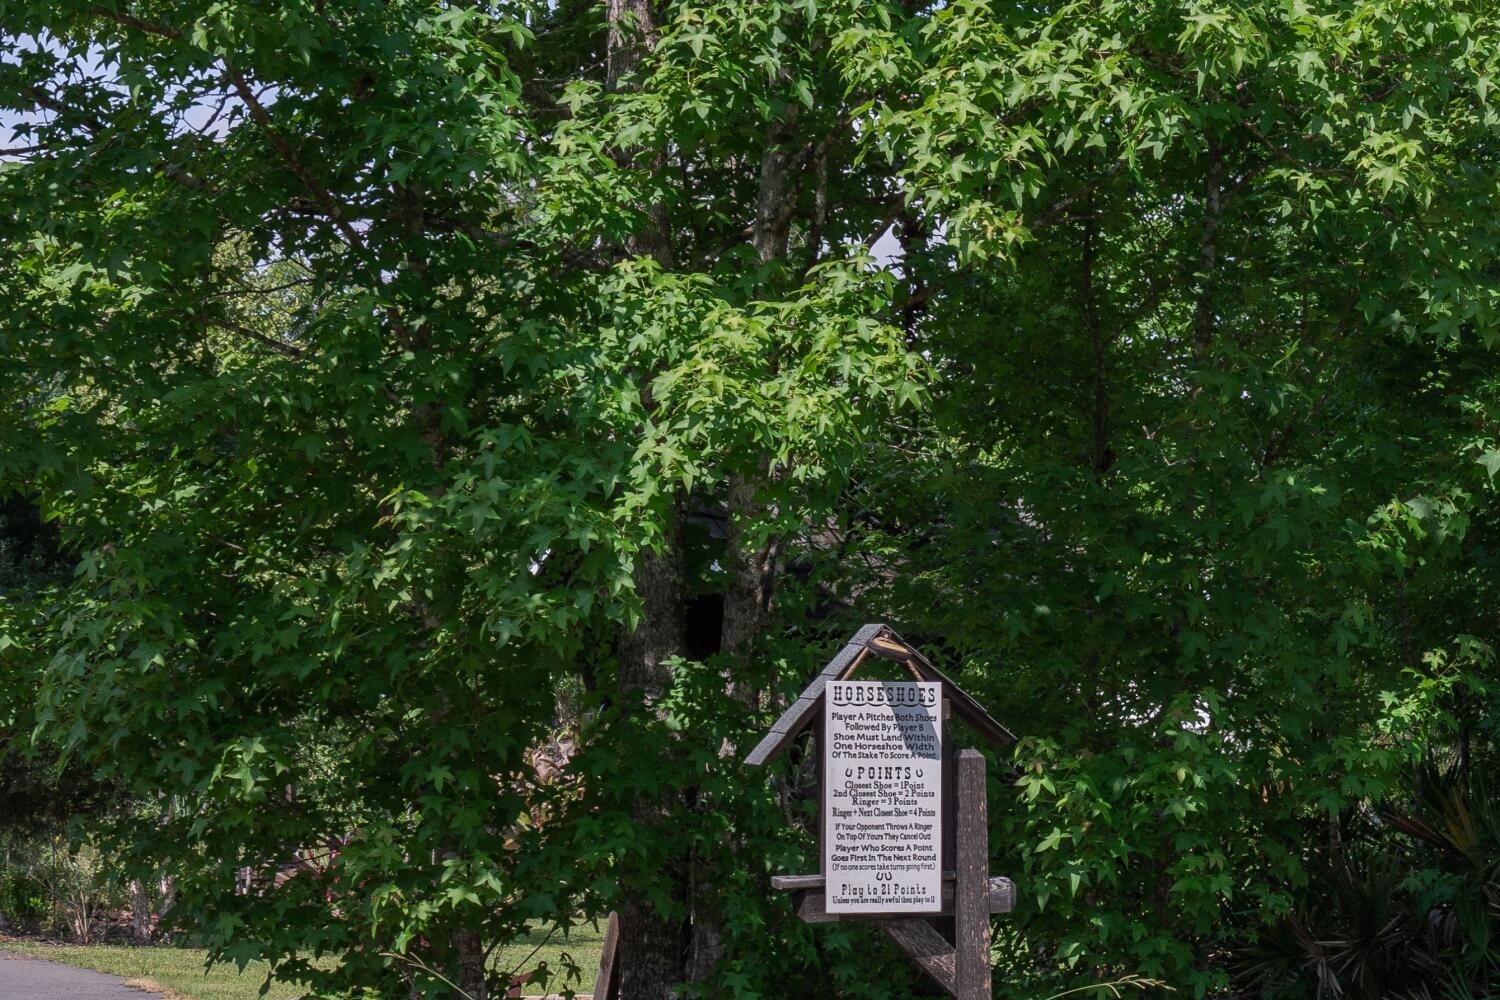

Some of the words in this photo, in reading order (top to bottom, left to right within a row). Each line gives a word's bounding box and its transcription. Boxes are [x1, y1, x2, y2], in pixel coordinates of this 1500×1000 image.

[833, 686, 935, 703] HORSESHOES
[832, 713, 857, 722] Player
[866, 713, 894, 722] Pitches
[895, 714, 914, 722] Both
[915, 714, 937, 722] Shoes
[845, 723, 880, 731] Followed
[882, 723, 892, 733] By
[893, 724, 918, 733] Player
[834, 733, 855, 741] Shoe
[857, 733, 879, 741] Must
[881, 733, 902, 741] Land
[903, 733, 935, 741] Within
[833, 742, 853, 750] One
[854, 742, 903, 750] Horseshoe
[906, 742, 934, 751] Width
[832, 751, 842, 759] Of
[917, 752, 937, 760] Point
[857, 766, 911, 780] POINTS
[845, 781, 872, 789] Closest
[873, 781, 893, 790] Shoe
[849, 789, 876, 797] Closest
[878, 789, 897, 798] Shoe
[911, 789, 935, 798] Points
[852, 797, 879, 807] Ringer
[887, 798, 892, 806] 3
[893, 798, 918, 806] Points
[832, 807, 852, 819] Ringer
[858, 807, 873, 817] Next
[873, 808, 894, 817] Closest
[894, 808, 908, 817] Shoe
[913, 808, 917, 817] 4
[918, 808, 936, 817] Points
[856, 823, 885, 832] Opponent
[886, 823, 908, 831] Throws
[909, 823, 913, 831] A
[914, 823, 933, 832] Ringer
[846, 833, 858, 842] Top
[884, 833, 899, 842] They
[835, 844, 860, 853] Player
[861, 844, 880, 852] Who
[881, 844, 904, 852] Scores
[913, 844, 933, 852] Point
[831, 854, 849, 862] Goes
[893, 854, 912, 862] Next
[877, 863, 890, 871] take
[906, 864, 921, 872] going
[841, 884, 864, 898] Play
[867, 884, 878, 895] to
[881, 884, 891, 895] 21
[894, 883, 927, 895] Points
[832, 896, 850, 904] Unless
[869, 896, 885, 905] really
[885, 896, 900, 904] awful
[901, 896, 913, 904] then
[913, 896, 924, 905] play
